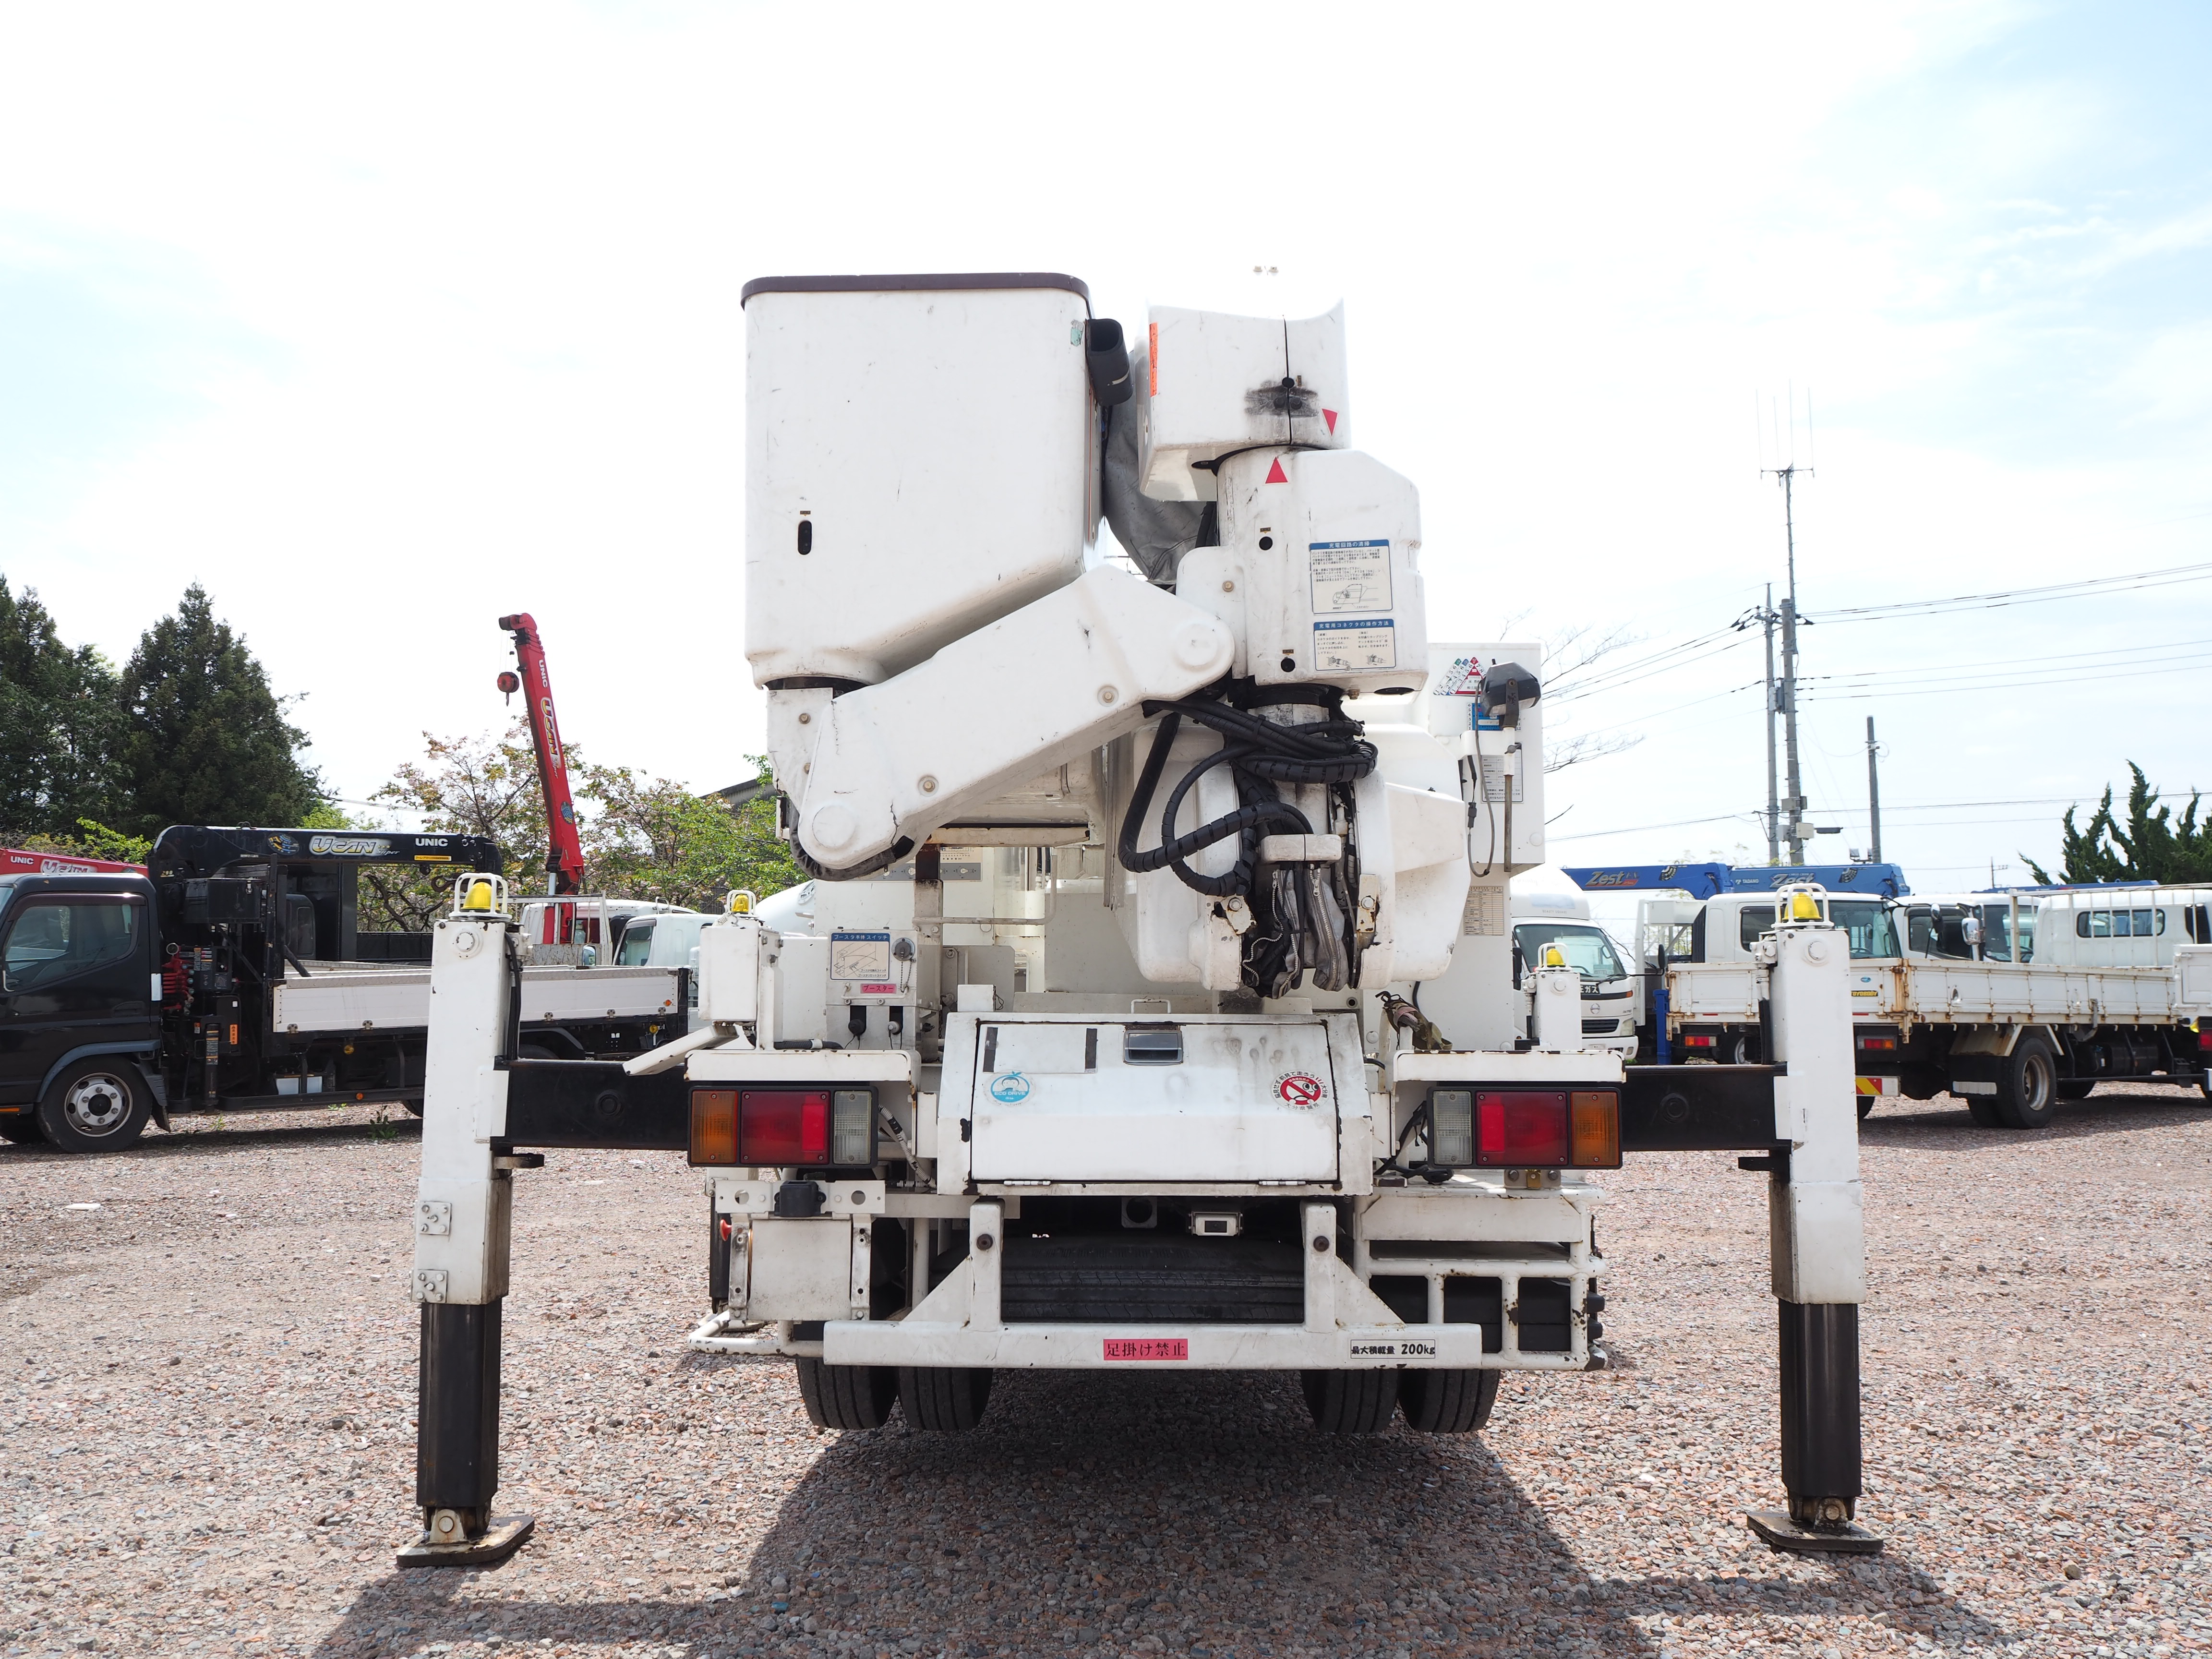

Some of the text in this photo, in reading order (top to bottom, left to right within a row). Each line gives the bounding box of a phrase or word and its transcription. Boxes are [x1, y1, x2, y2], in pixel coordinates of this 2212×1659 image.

[1319, 621, 1389, 629] 充電用コネクタの操作方法
[539, 659, 548, 688] UNIC
[312, 837, 376, 854] UCAN
[415, 838, 448, 847] UNIC
[11, 856, 34, 865] UNIC
[1586, 871, 1625, 885] Zest
[1769, 873, 1815, 888] Zest
[1106, 1342, 1186, 1357] 足掛け禁止
[1351, 1344, 1435, 1355] 最大積載量 200kg
